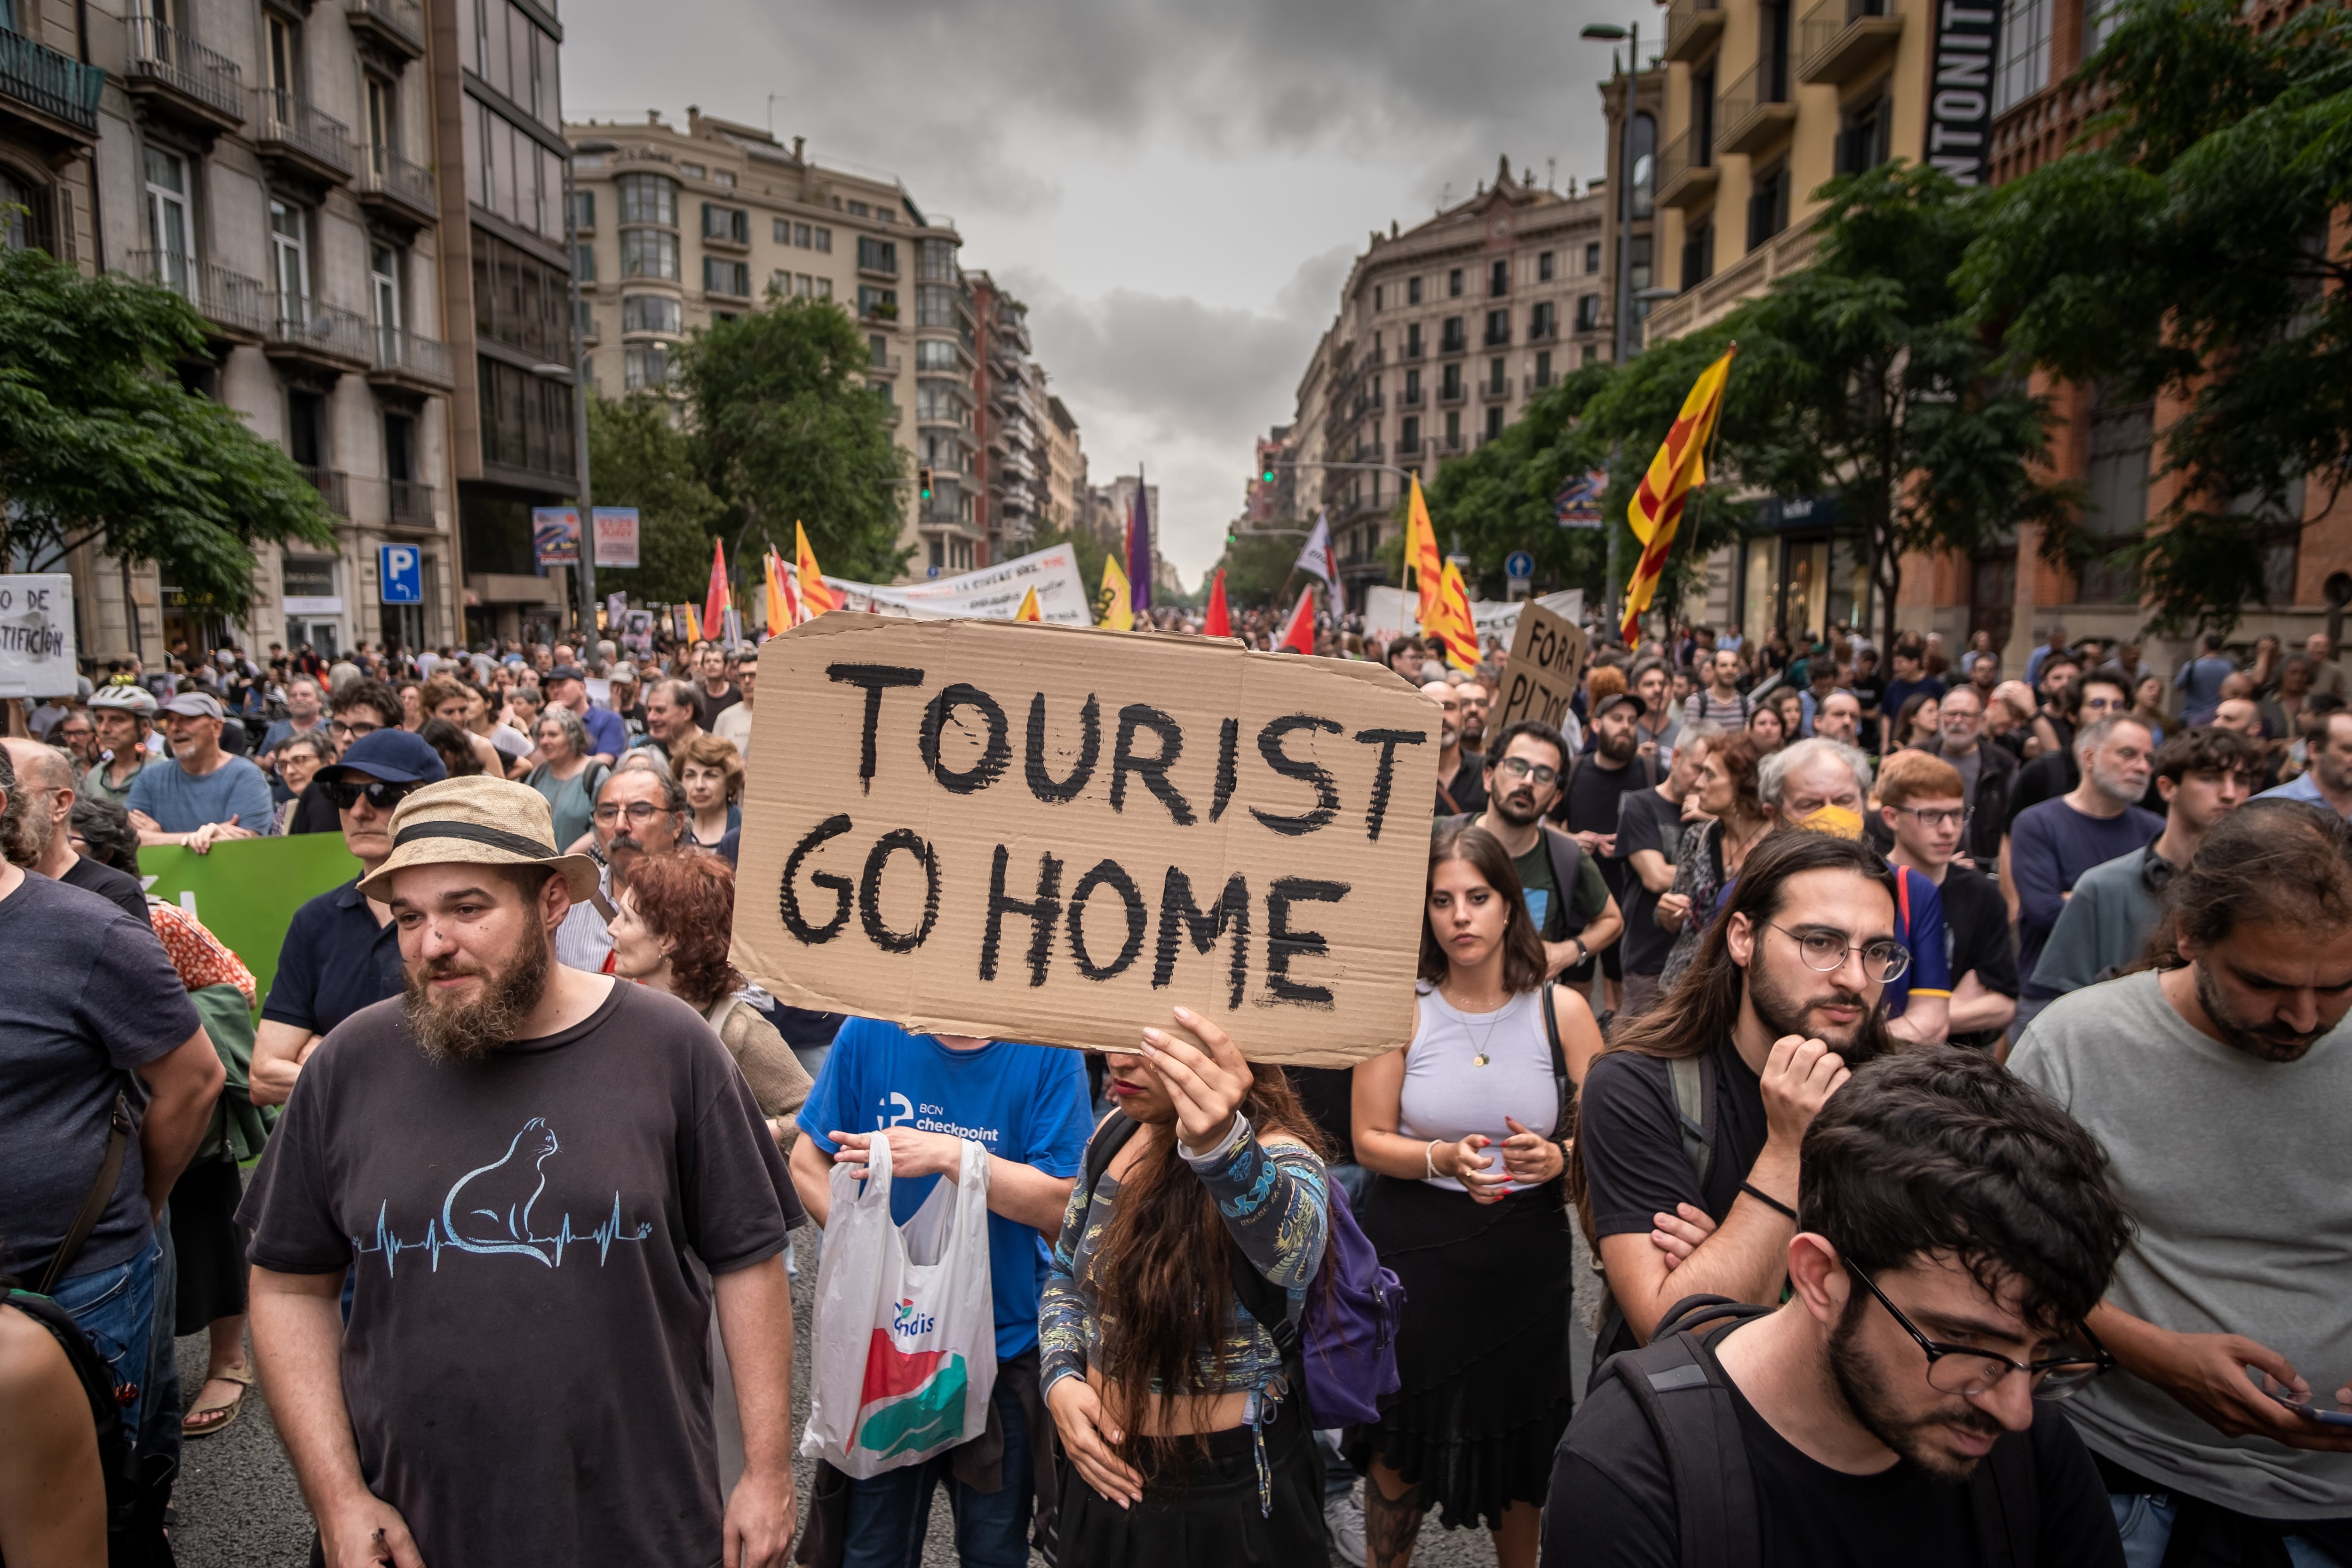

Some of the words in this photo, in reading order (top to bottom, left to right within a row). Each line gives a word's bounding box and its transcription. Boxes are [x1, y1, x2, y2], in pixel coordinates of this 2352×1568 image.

[389, 549, 413, 580] P
[27, 589, 49, 610] DE
[0, 622, 64, 657] TIFICIÓN
[1526, 618, 1576, 677] FORA
[826, 661, 1427, 844] TOURIST
[780, 813, 942, 955] GO
[977, 843, 1352, 1013] HOME
[919, 1103, 944, 1116] BCN
[916, 1117, 999, 1141] checkpoint
